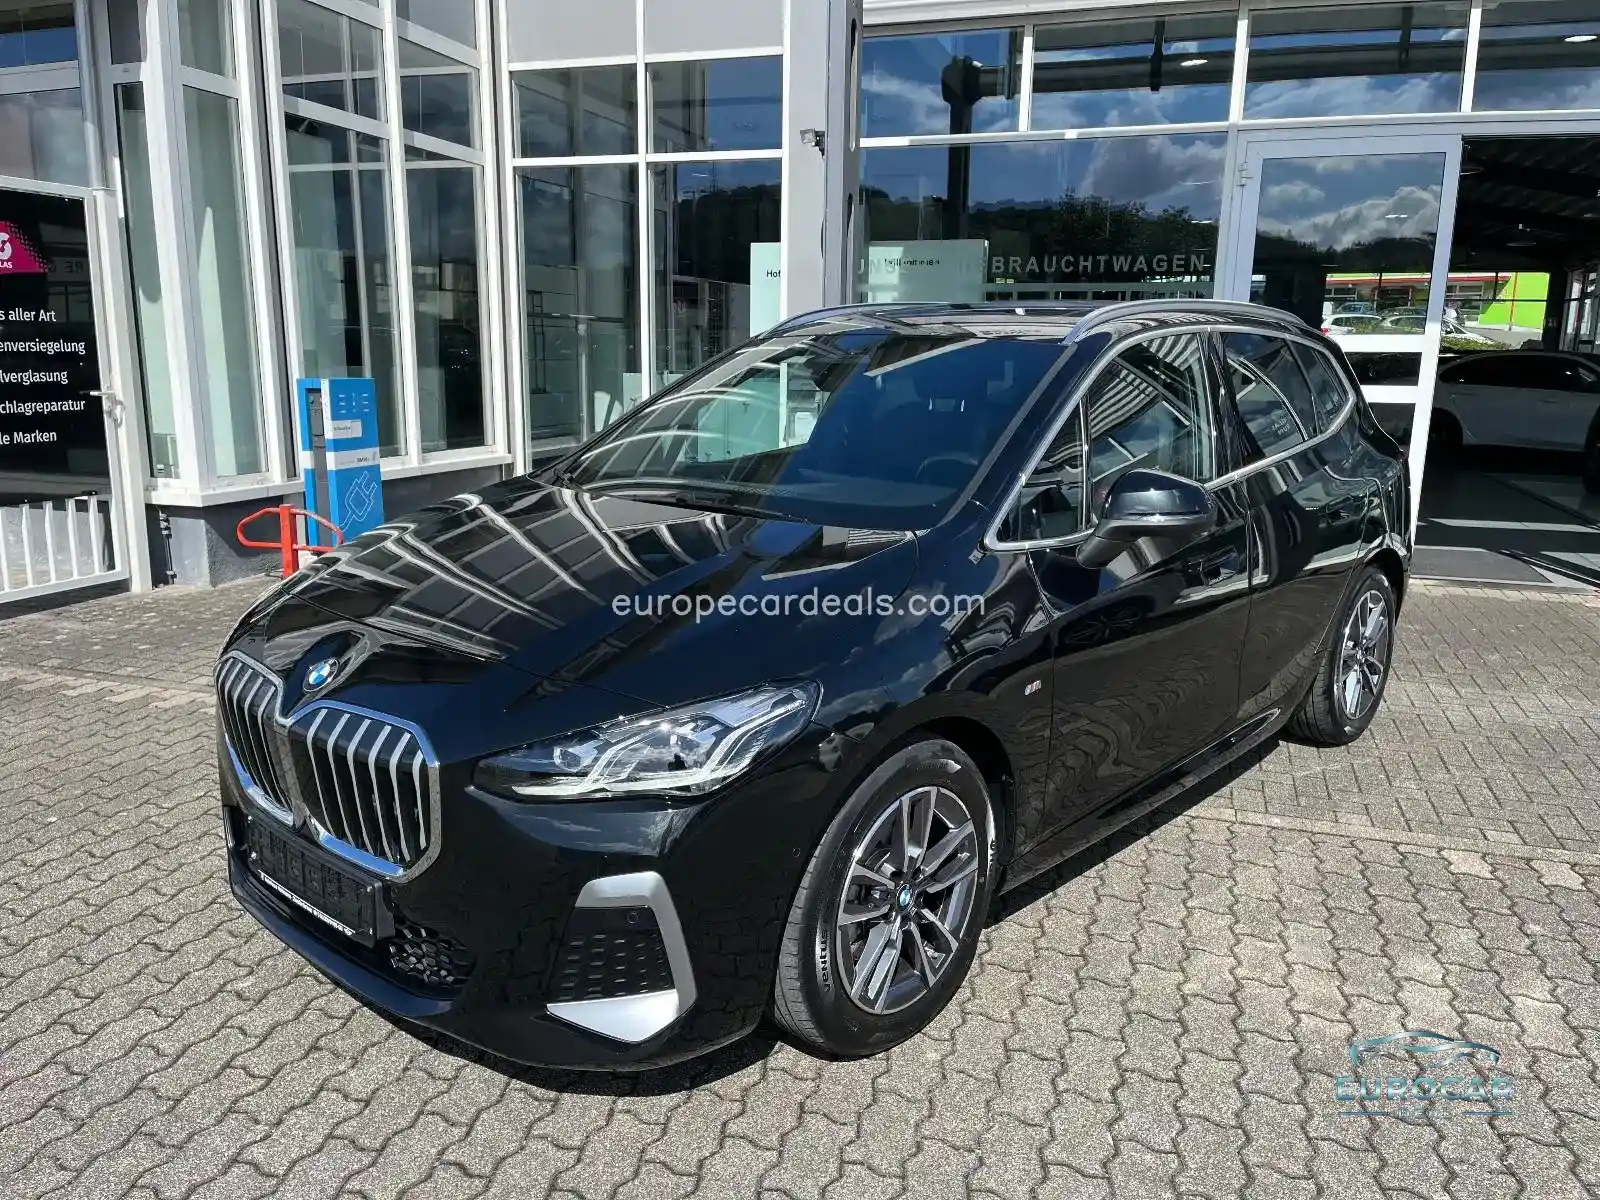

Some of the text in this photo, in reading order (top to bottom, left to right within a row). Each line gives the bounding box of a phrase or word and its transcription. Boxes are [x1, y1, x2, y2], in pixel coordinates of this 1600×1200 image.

[8, 307, 36, 321] aller
[38, 309, 57, 322] Art
[0, 399, 86, 416] chlagreparatur
[13, 429, 57, 444] Marken
